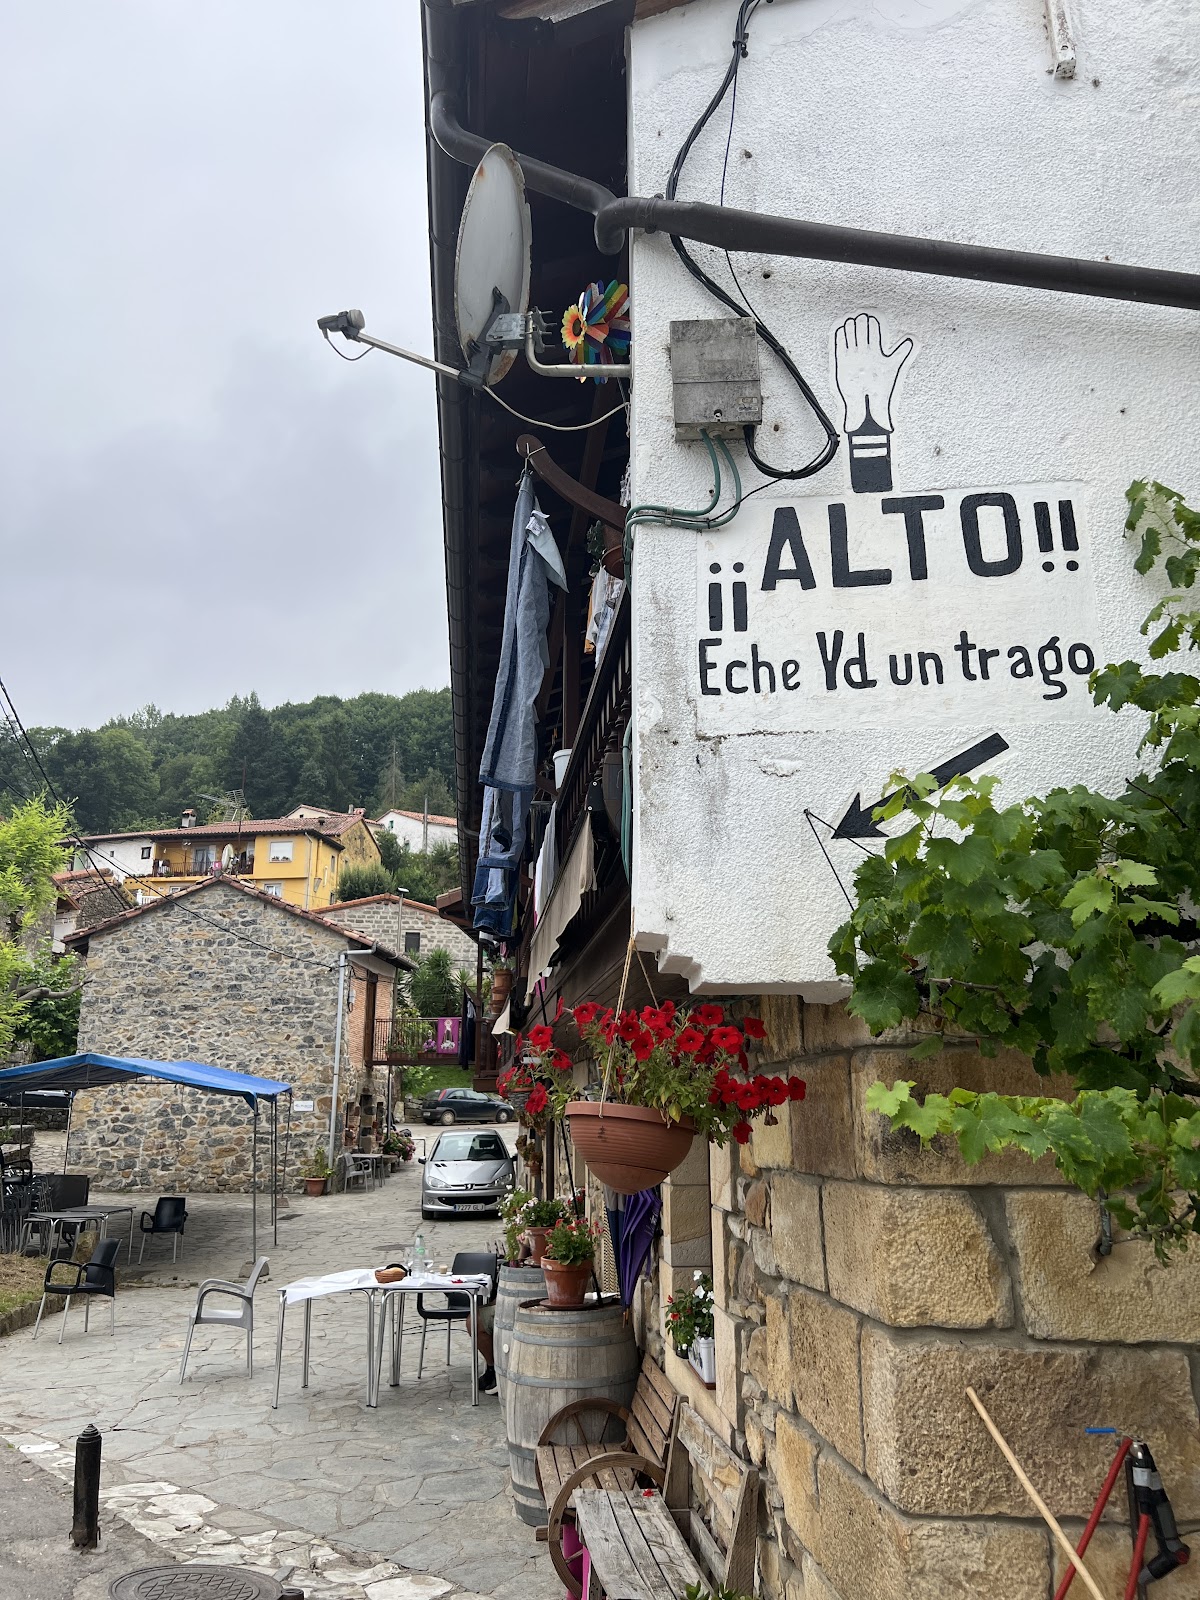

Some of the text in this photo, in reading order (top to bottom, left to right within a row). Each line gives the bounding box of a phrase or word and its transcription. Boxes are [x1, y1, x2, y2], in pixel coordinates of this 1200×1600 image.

[698, 637, 801, 696] Eche
[888, 651, 944, 686] un
[953, 630, 1095, 701] trago
